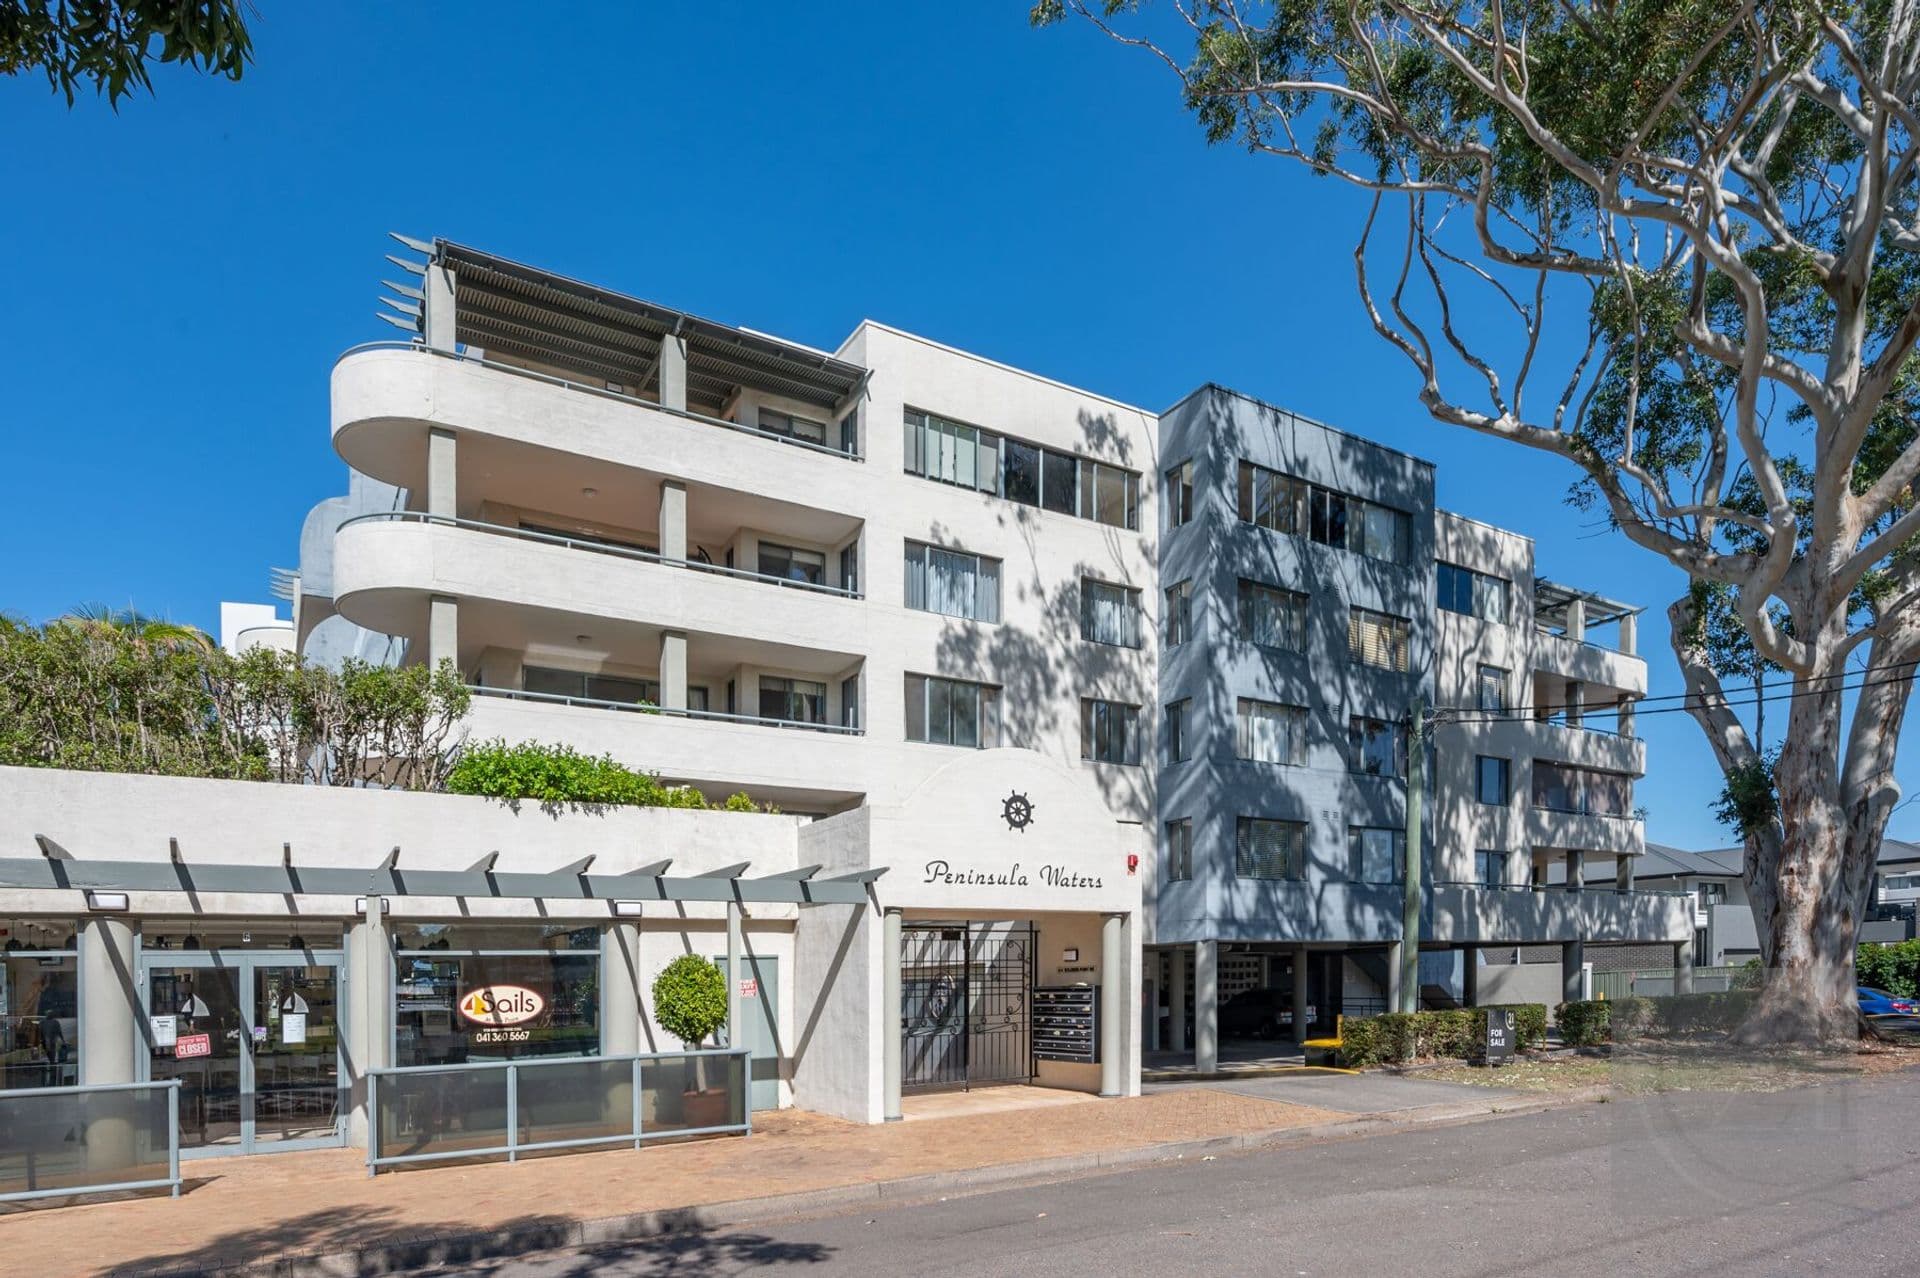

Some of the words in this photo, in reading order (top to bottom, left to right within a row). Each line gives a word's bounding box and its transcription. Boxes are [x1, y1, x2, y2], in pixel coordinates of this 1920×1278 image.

[924, 860, 1029, 886] Peninsula
[1039, 865, 1103, 888] Waters
[481, 991, 535, 1013] Sails
[476, 1033, 490, 1042] 041
[492, 1031, 508, 1041] 360
[510, 1031, 530, 1041] 5667
[1490, 1029, 1502, 1037] FOR
[178, 1042, 208, 1055] CLOSED
[1490, 1038, 1505, 1047] SALE
